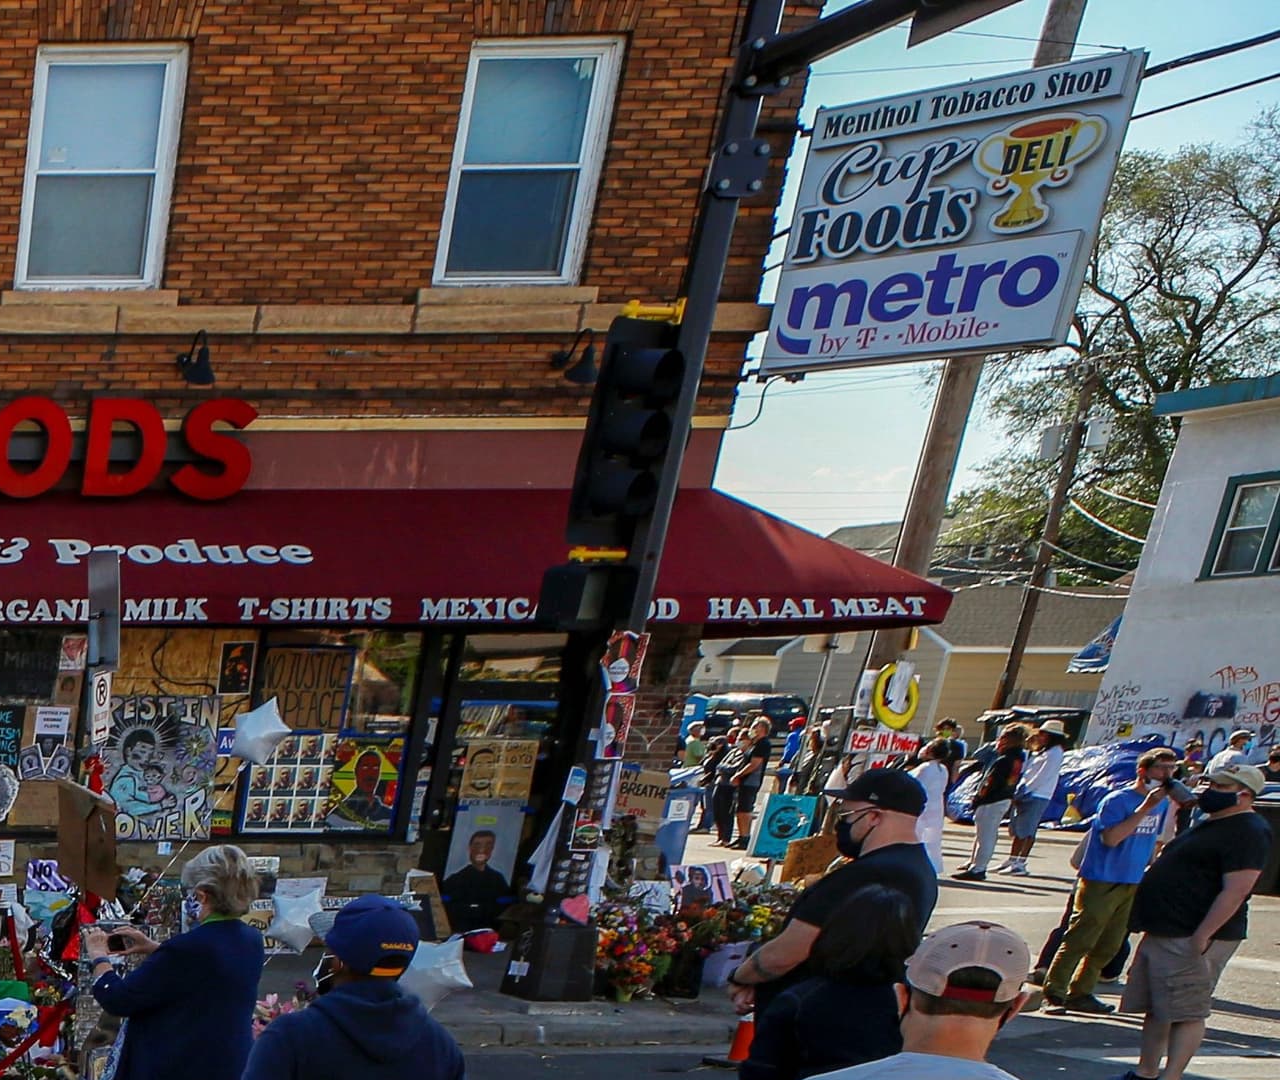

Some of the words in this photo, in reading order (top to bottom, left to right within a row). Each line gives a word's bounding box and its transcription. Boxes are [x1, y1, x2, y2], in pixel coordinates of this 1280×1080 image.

[823, 99, 922, 139] Menthol
[931, 83, 1035, 120] Tobacco
[1045, 66, 1112, 99] Shop
[822, 139, 977, 206] Cup
[1001, 134, 1070, 177] DELI
[791, 190, 972, 262] Foods
[786, 253, 1060, 331] metro
[819, 332, 849, 358] by
[50, 538, 313, 566] Produce
[124, 598, 208, 622] MILK
[240, 597, 391, 622] T-SHIRTS
[420, 598, 536, 621] MEXIC
[707, 598, 824, 620] HALAL
[830, 596, 927, 619] MEAT
[284, 654, 346, 689] JUSTICE
[109, 697, 171, 728] REST
[181, 697, 220, 743] IN
[284, 690, 343, 728] PEACE
[876, 732, 890, 749] IN
[621, 782, 668, 799] BREATHE
[115, 789, 210, 840] OWER
[32, 862, 52, 879] NO
